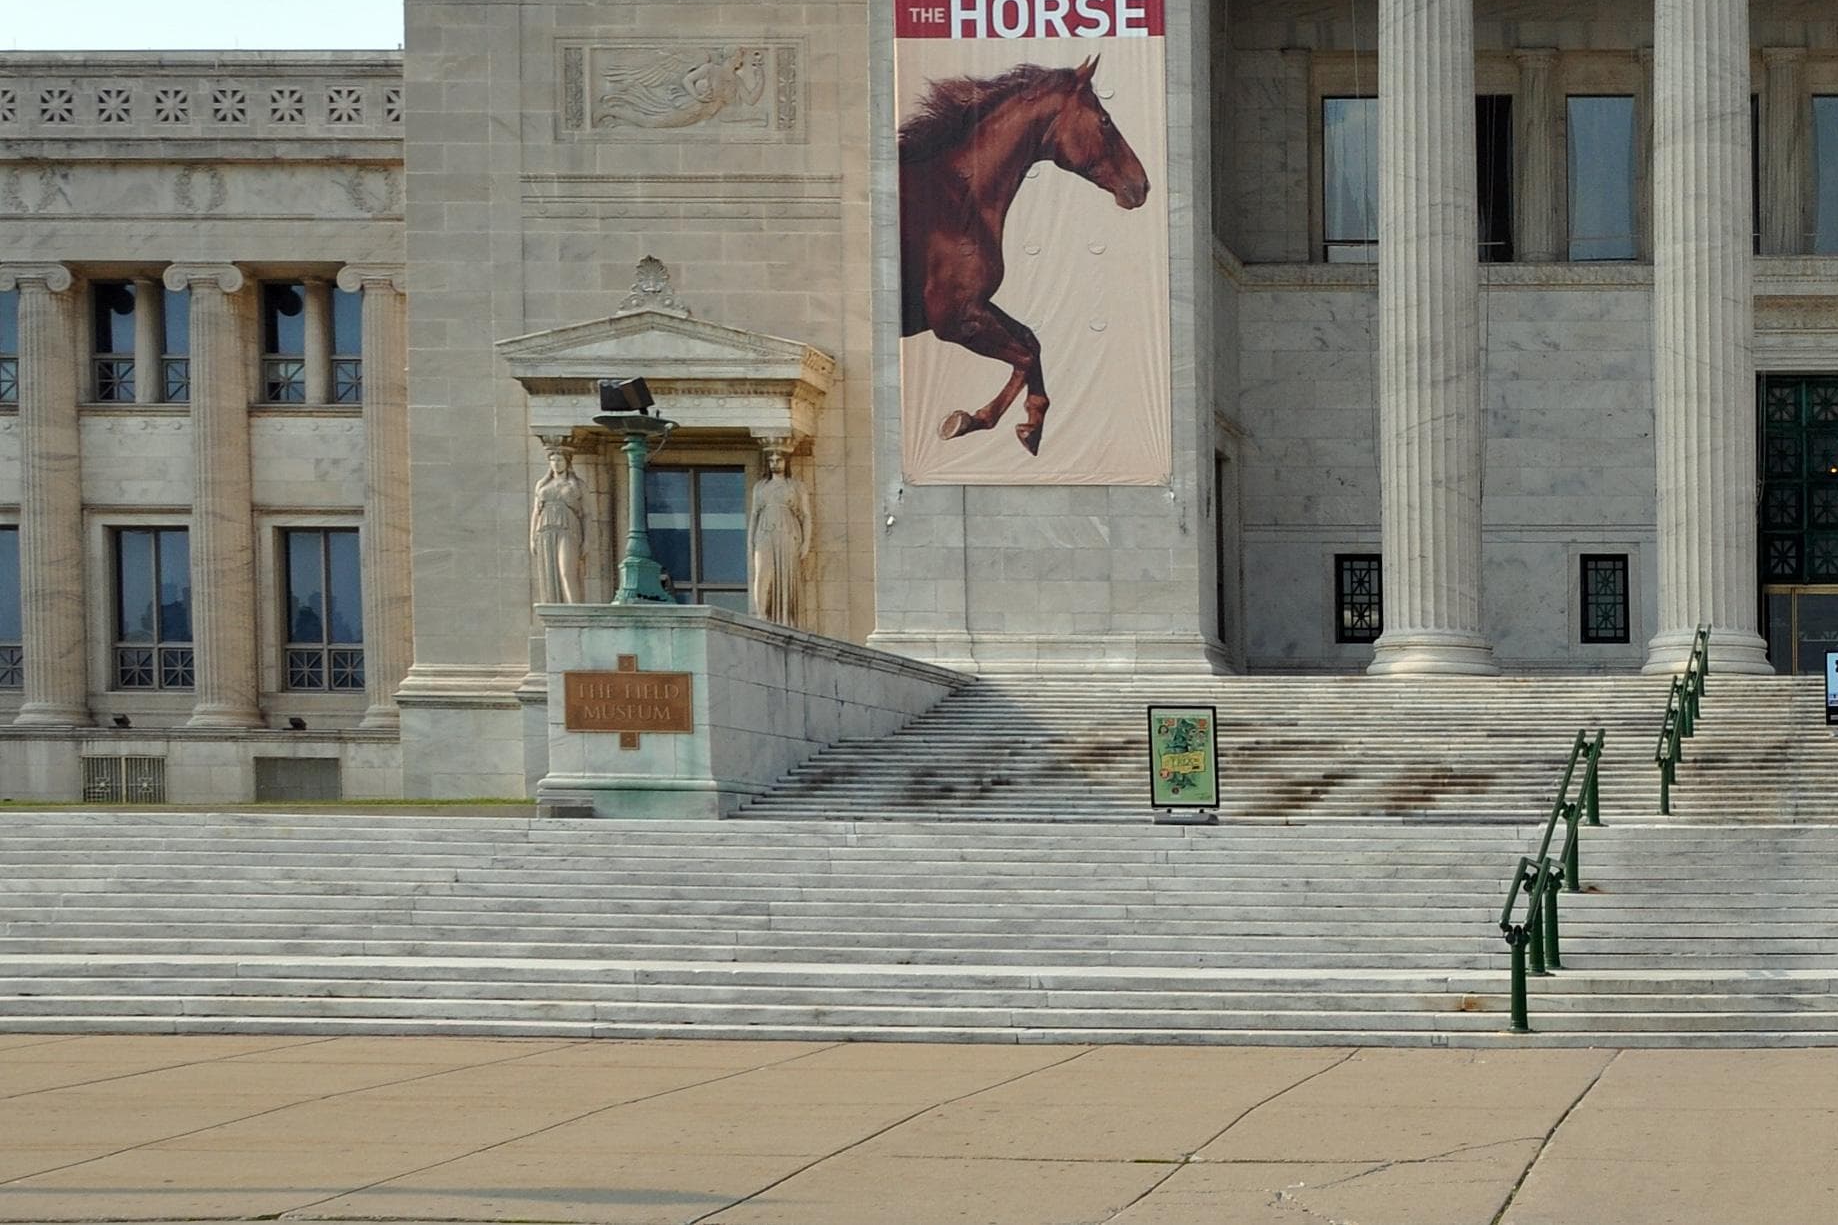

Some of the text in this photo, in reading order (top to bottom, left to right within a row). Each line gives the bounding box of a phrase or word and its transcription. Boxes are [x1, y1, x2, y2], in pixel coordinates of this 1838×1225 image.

[908, 8, 945, 23] THE
[579, 684, 681, 699] THE FIELD
[584, 704, 672, 720] MUSEUM
